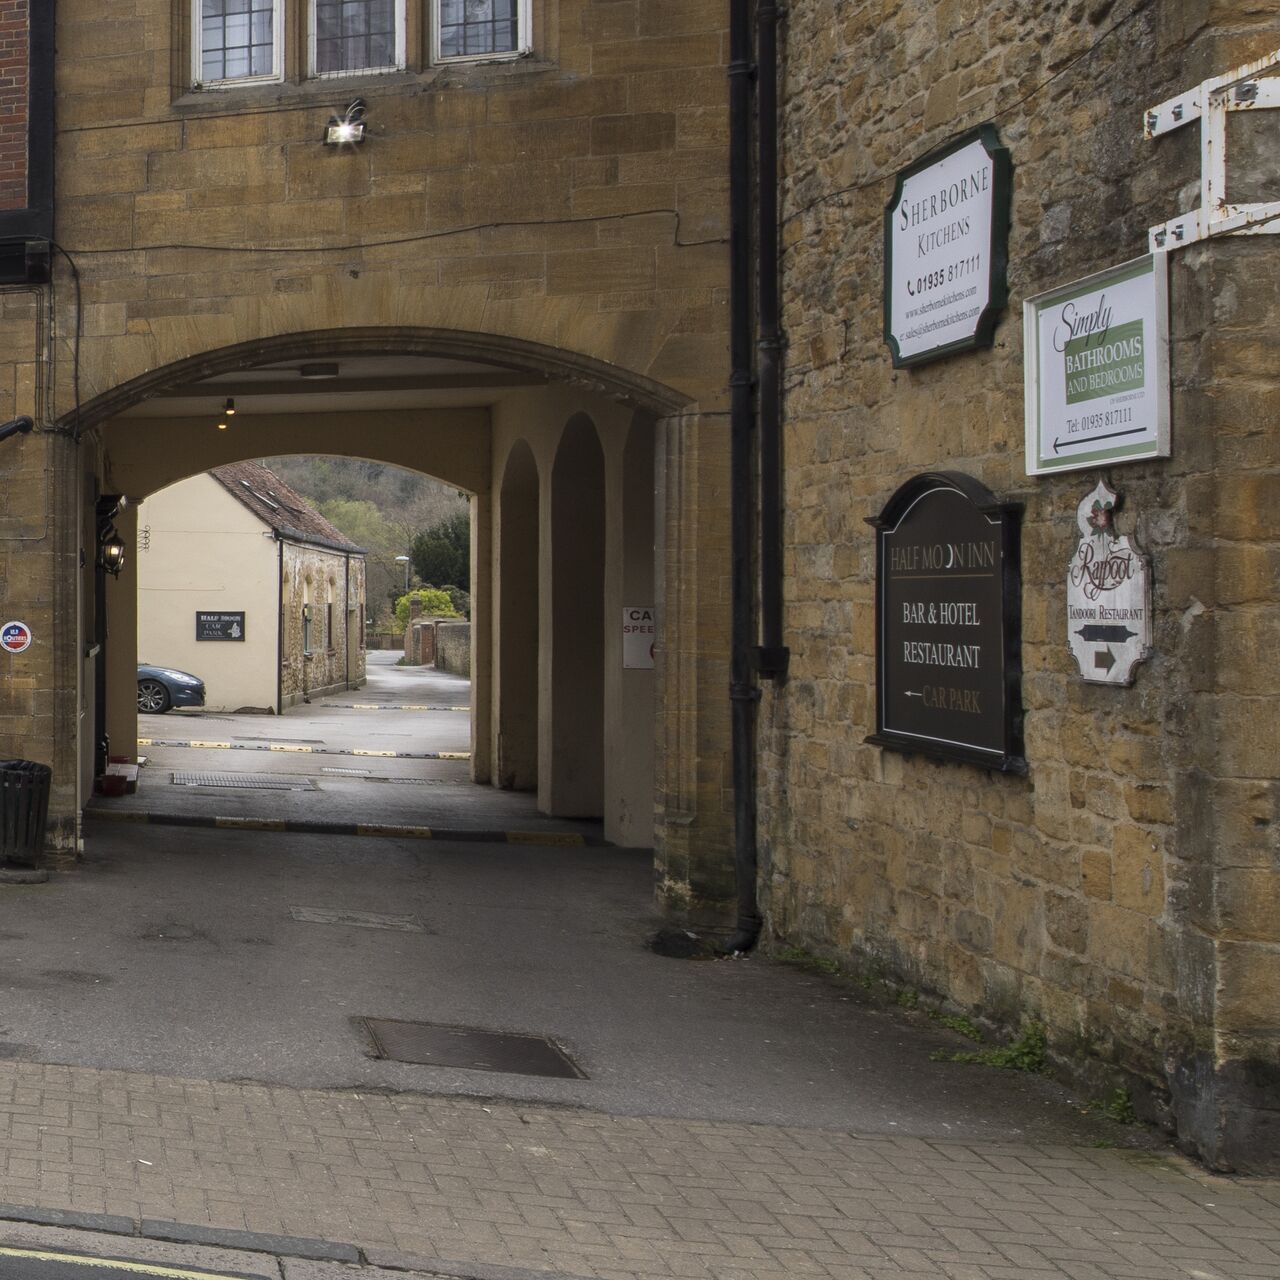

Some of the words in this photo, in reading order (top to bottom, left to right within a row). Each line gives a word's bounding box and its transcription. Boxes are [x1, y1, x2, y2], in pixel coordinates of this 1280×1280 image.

[900, 166, 989, 232] SHERBORNE
[917, 216, 971, 258] KITCHENS
[916, 269, 945, 294] 01935
[947, 253, 981, 282] 817111
[905, 284, 977, 320] www.sherbornekitchens.com
[1053, 294, 1113, 353] Simply
[1066, 336, 1142, 374] BATHROOMS
[1067, 376, 1088, 395] AND
[1089, 363, 1143, 390] BEDROOMS
[1067, 419, 1080, 434] Tel:
[1081, 413, 1104, 431] 01935
[1105, 407, 1133, 426] 817111
[890, 546, 920, 571] HALF
[968, 541, 995, 568] INN
[1071, 540, 1135, 601] Rajpoot
[630, 610, 652, 621] CA
[903, 602, 925, 624] BAR
[927, 602, 937, 624] &
[939, 602, 981, 626] HOTEL
[1069, 605, 1097, 620] TANDOORI
[1099, 605, 1144, 620] RESTAURANT
[624, 625, 655, 633] SPEE
[903, 641, 981, 669] RESTAURANT
[921, 685, 948, 709] CAR
[949, 689, 982, 714] PARK
